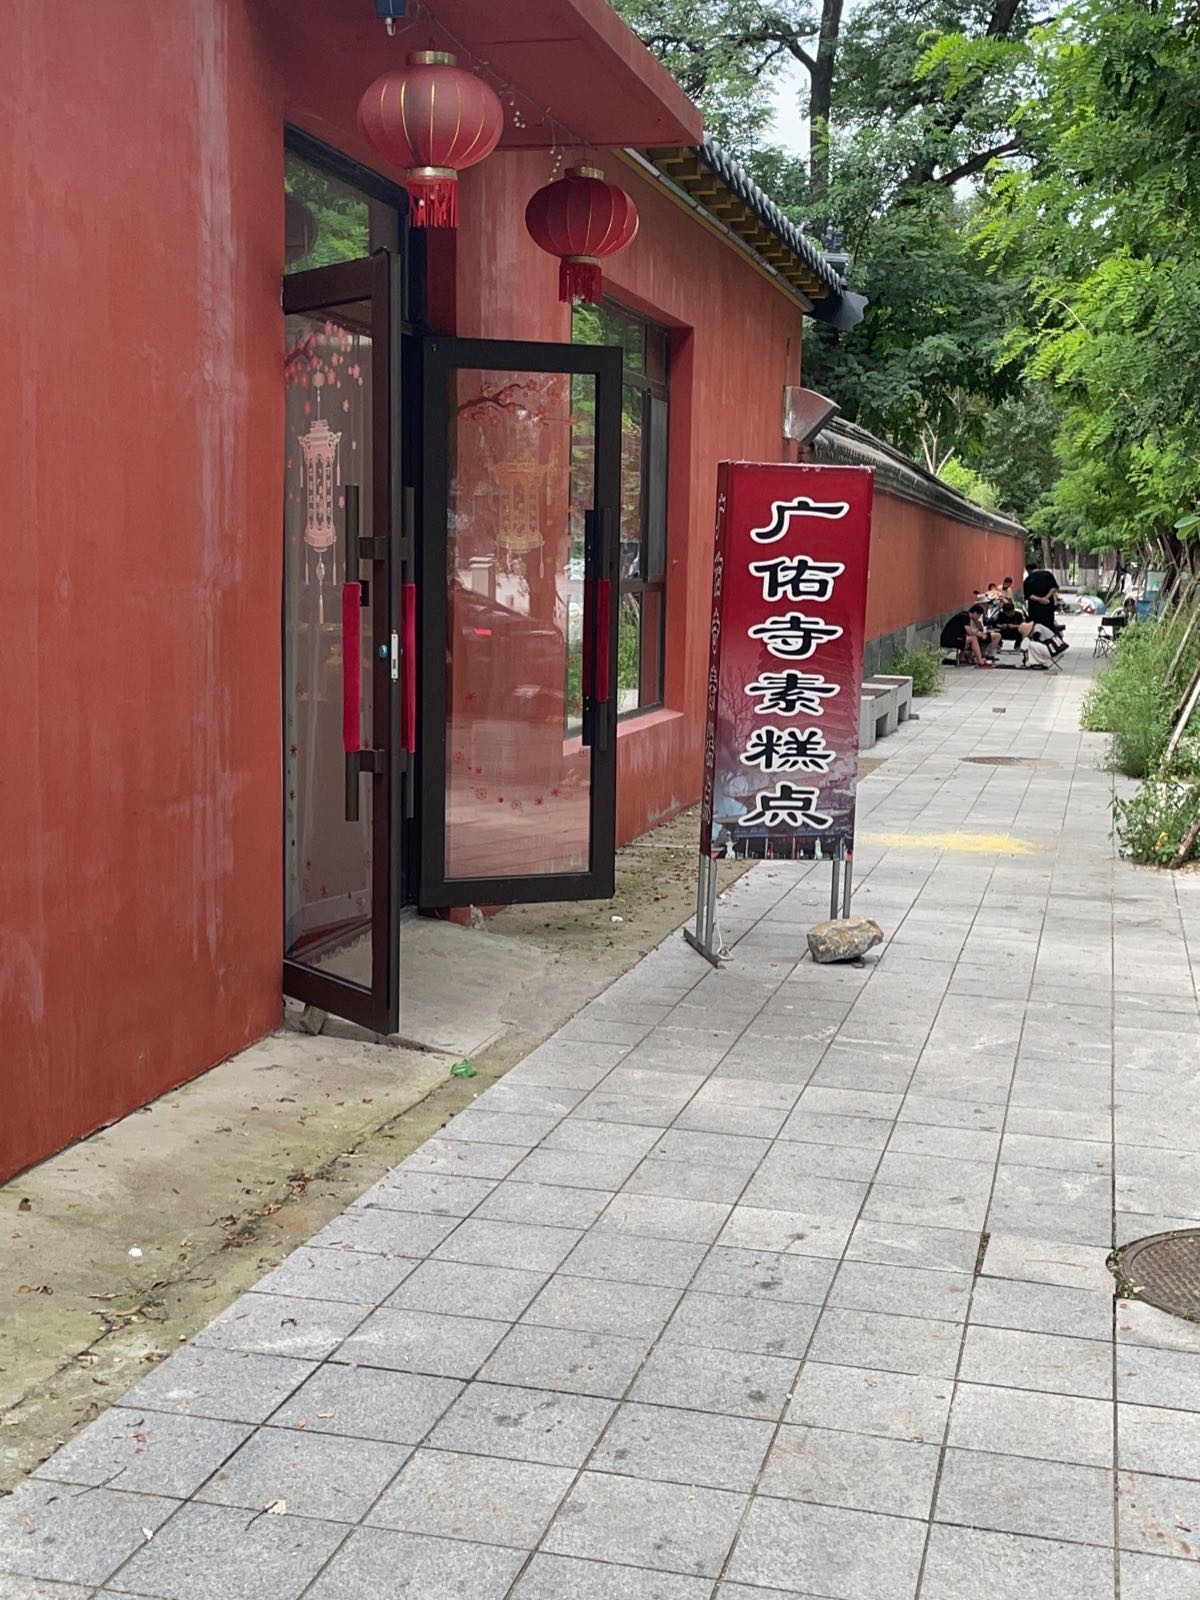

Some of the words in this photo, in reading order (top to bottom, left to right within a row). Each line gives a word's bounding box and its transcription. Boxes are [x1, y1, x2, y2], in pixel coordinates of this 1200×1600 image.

[739, 497, 850, 829] 广佑寺素糕点
